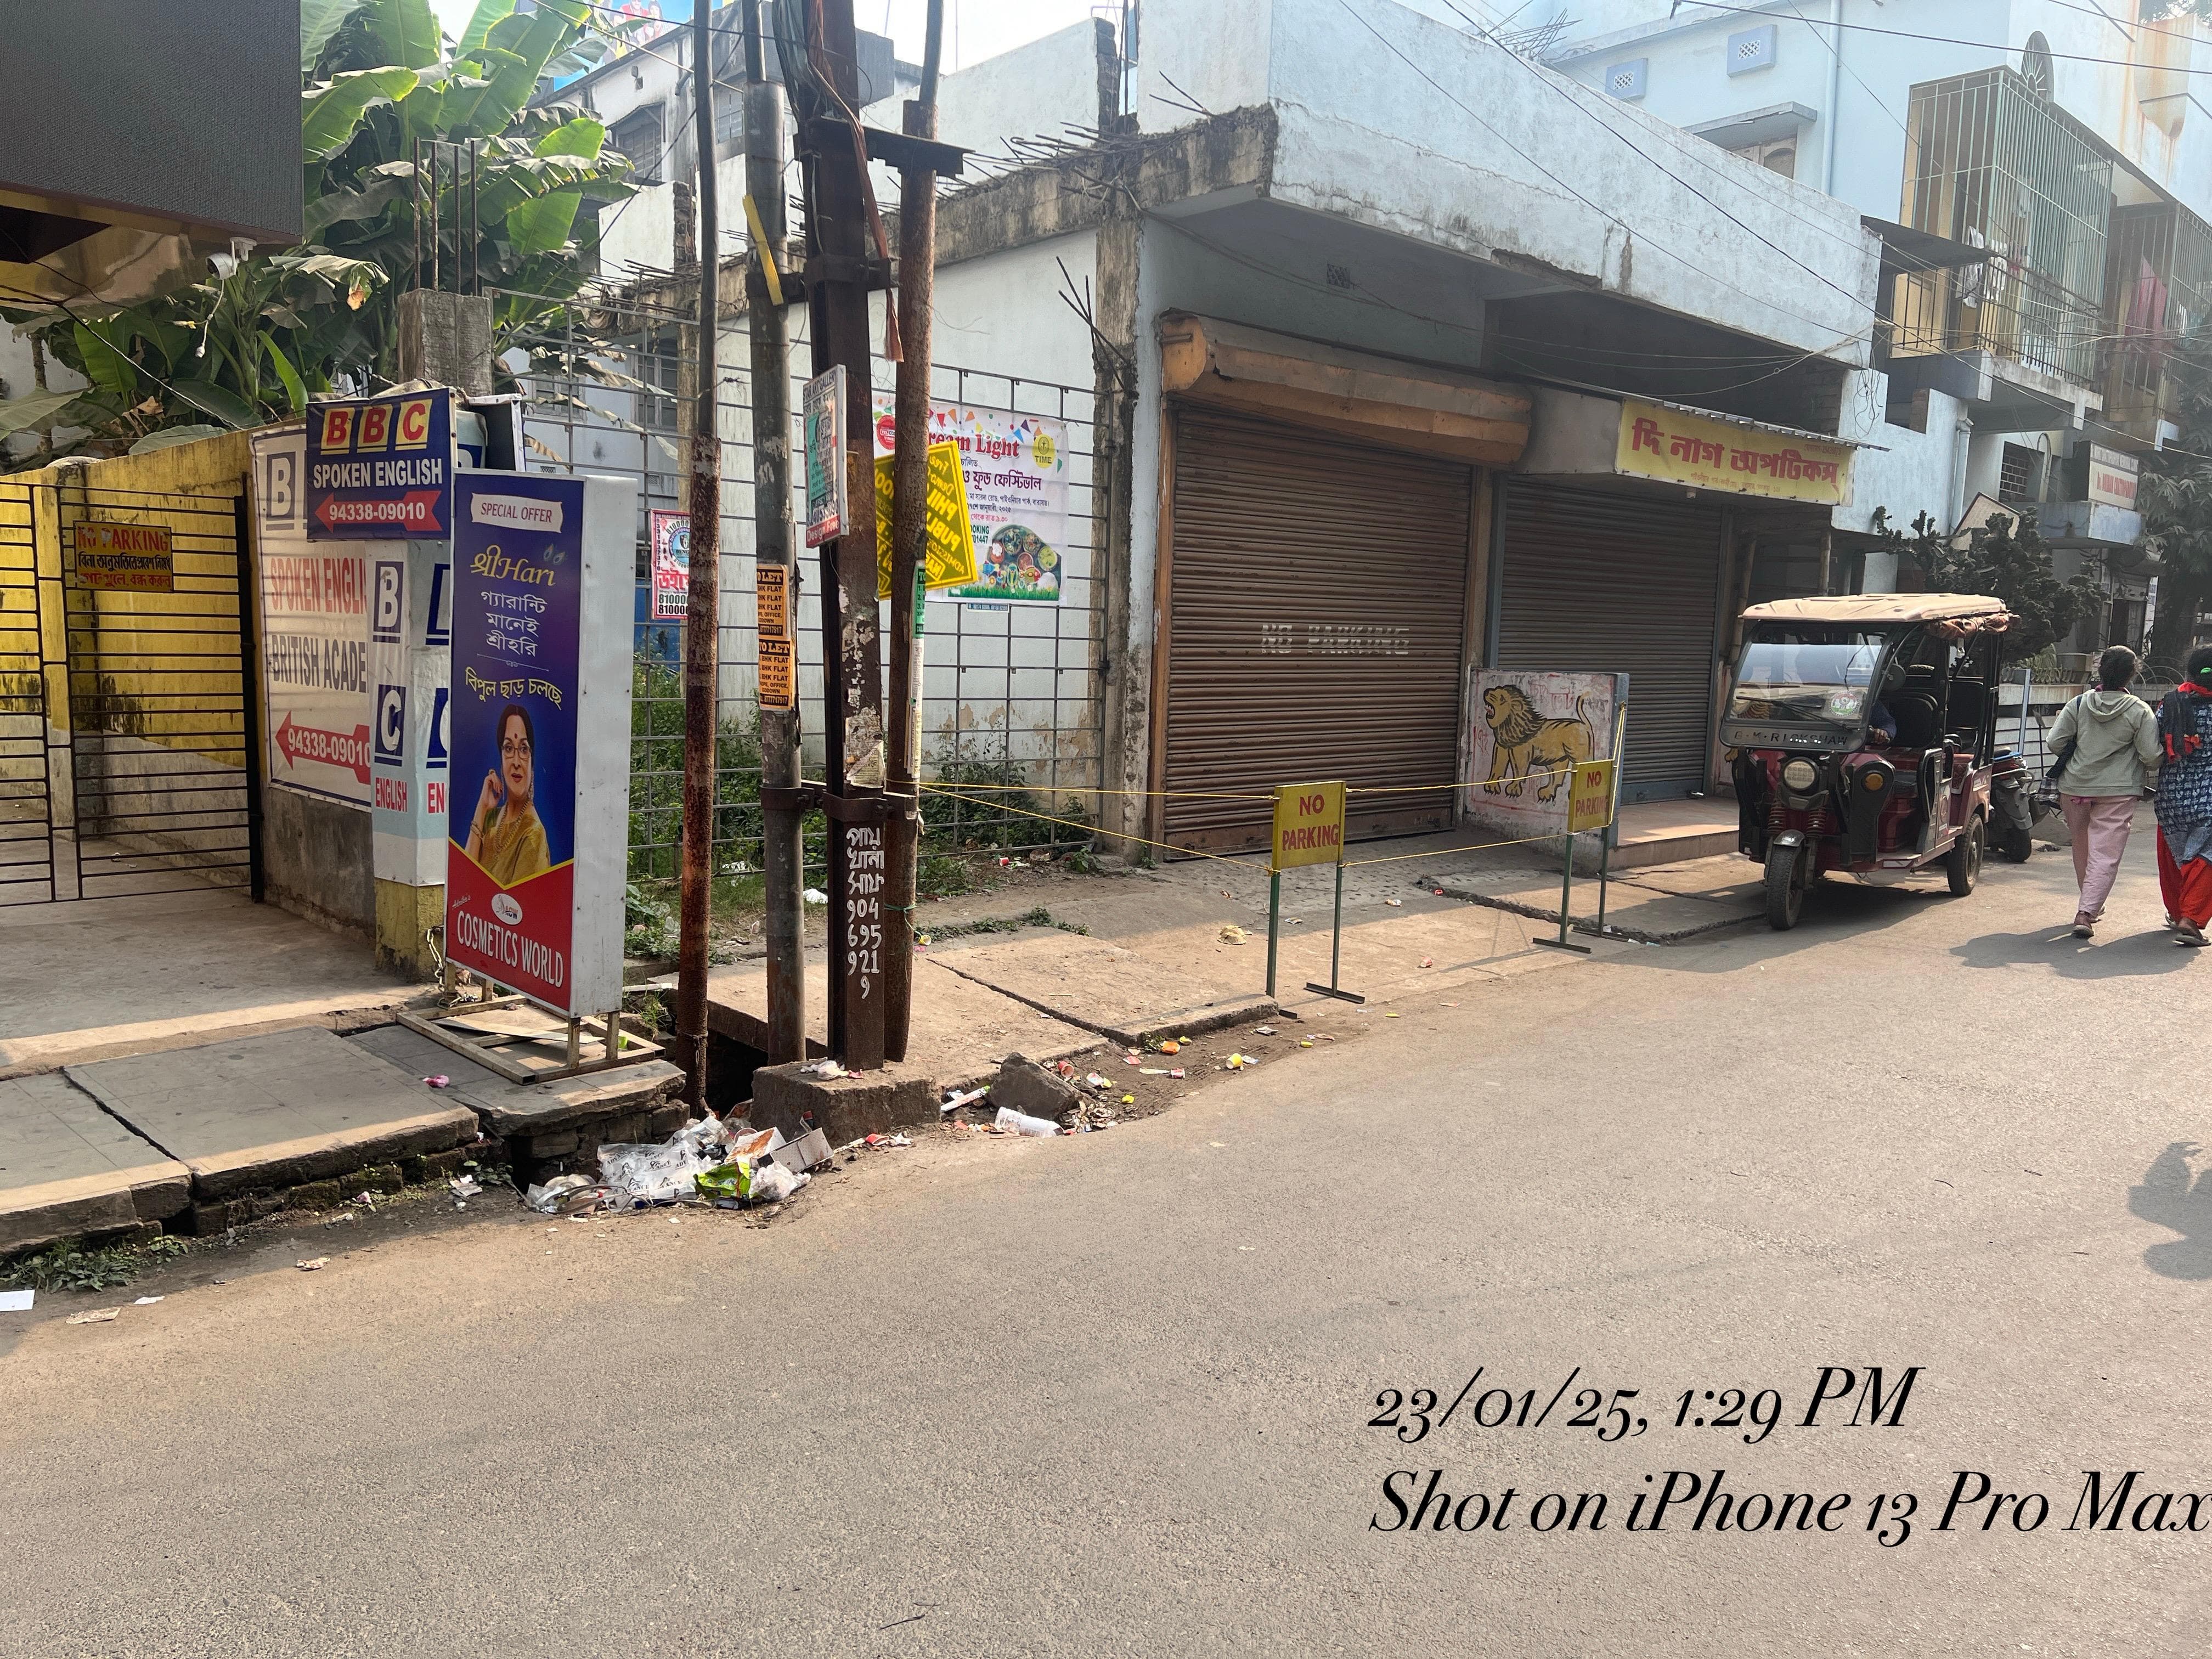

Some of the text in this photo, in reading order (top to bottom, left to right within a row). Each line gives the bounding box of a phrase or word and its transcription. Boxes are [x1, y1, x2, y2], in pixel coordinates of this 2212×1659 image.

[326, 403, 426, 446] BBC
[929, 433, 1020, 459] ream Light
[1632, 416, 1664, 456] দি
[1670, 435, 1725, 469] নাগ
[1035, 455, 1052, 464] TIME
[313, 458, 442, 489] SPOKEN ENGLISH
[994, 469, 1042, 490] ফেস্টিভাল
[329, 502, 425, 521] 94338-09010
[481, 501, 552, 523] SPECIAL OFFER
[806, 520, 839, 542] Design Free
[77, 551, 95, 569] বিনা
[270, 557, 367, 615] SPOKEN ENGLI
[481, 591, 548, 614] গ্যারান্টি
[658, 594, 689, 605] 81000
[658, 604, 689, 615] 81000
[485, 612, 540, 637] মানেই
[486, 629, 538, 657] শ্রীহরি
[1262, 623, 1410, 655] NO PARKING
[272, 635, 369, 693] BRITISH ACADE
[774, 665, 788, 673] FLAT
[465, 667, 563, 711] বিপুল ছাড় চলছে
[774, 674, 788, 682] FLAT
[375, 777, 408, 812] ENGLISH
[1575, 770, 1609, 818] NO PARKING
[1282, 794, 1340, 851] NO PARKING
[846, 897, 878, 923] 904
[457, 910, 563, 988] COSMETICS WORLD
[848, 924, 882, 950] 695
[848, 950, 880, 976] 921
[860, 975, 870, 1000] 9
